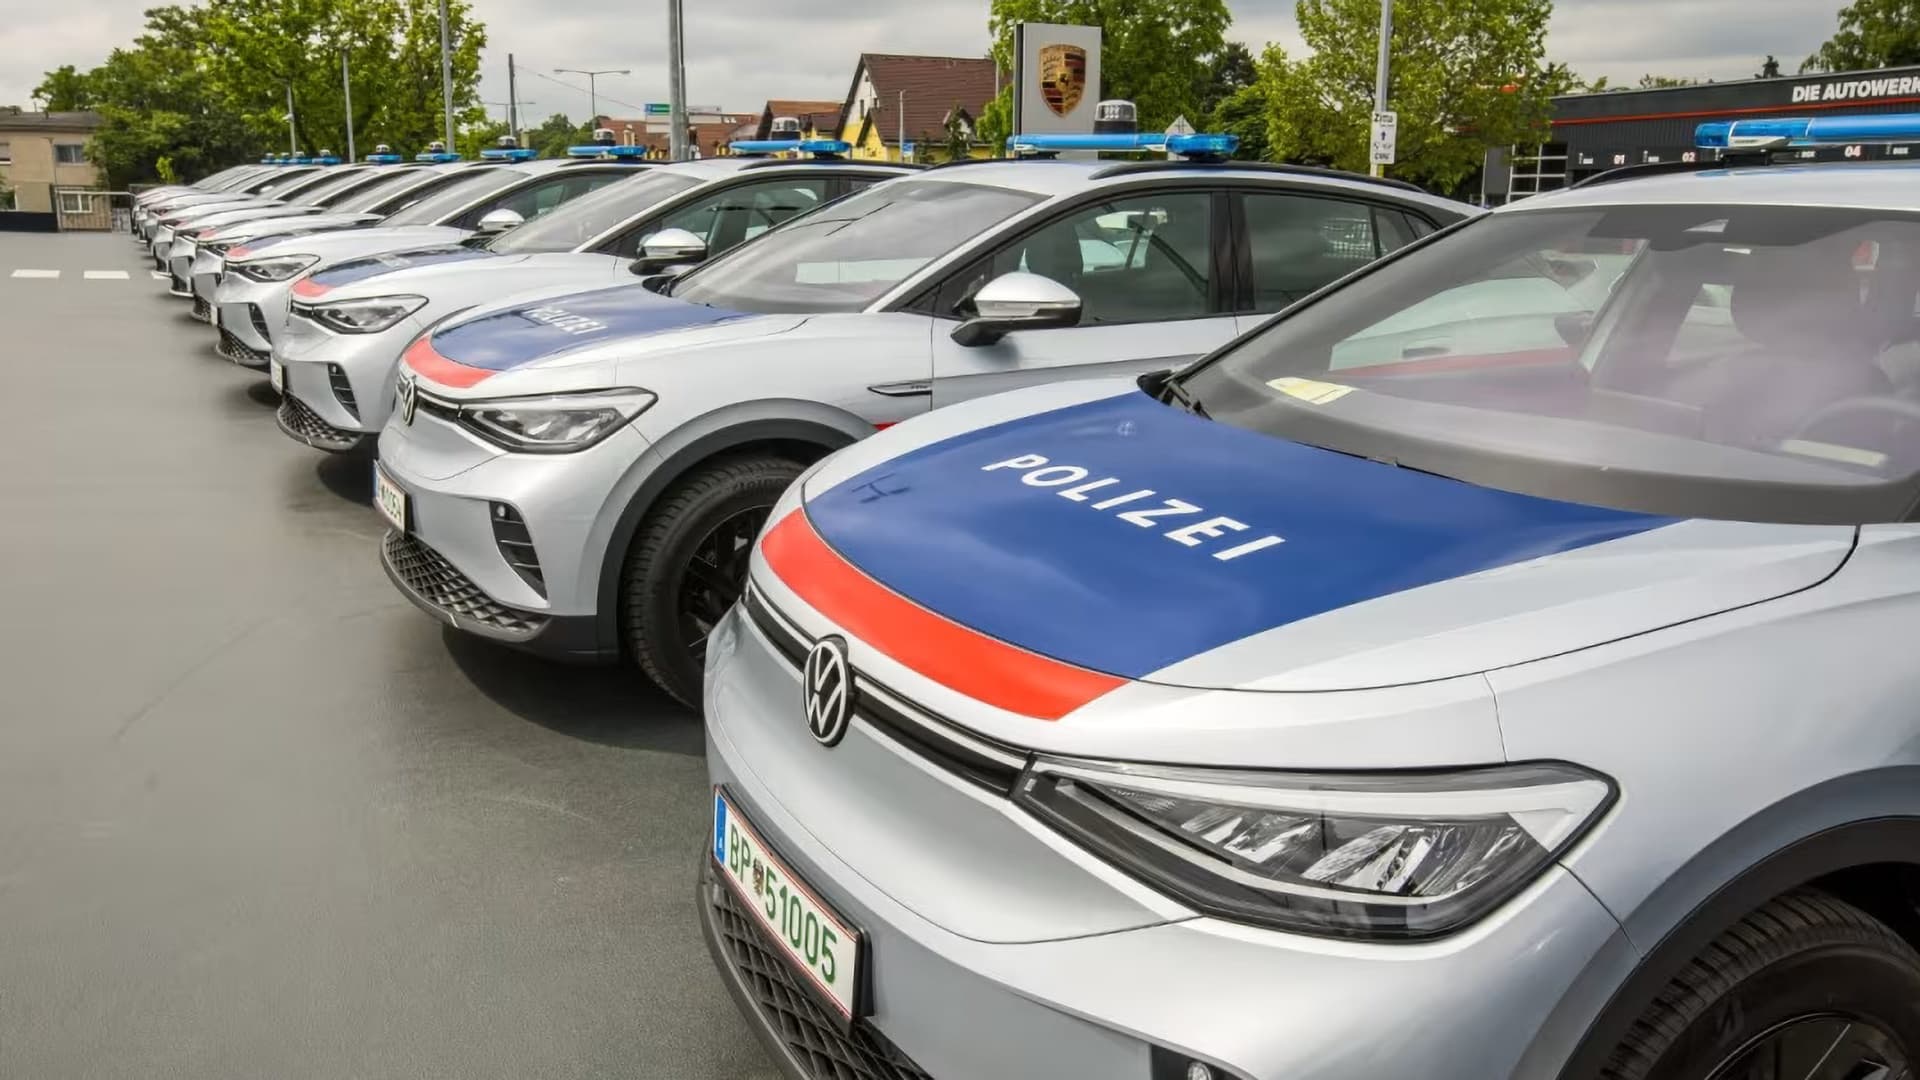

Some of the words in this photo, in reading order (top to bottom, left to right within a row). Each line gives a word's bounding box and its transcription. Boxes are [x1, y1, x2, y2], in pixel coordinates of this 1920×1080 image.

[1792, 84, 1821, 102] DIE
[1613, 154, 1625, 165] 01
[1682, 151, 1696, 163] 02
[1844, 145, 1861, 158] 04
[981, 453, 1286, 561] POLIZEI
[804, 639, 847, 743] VW
[729, 823, 751, 884] BP
[764, 865, 838, 985] 51005
